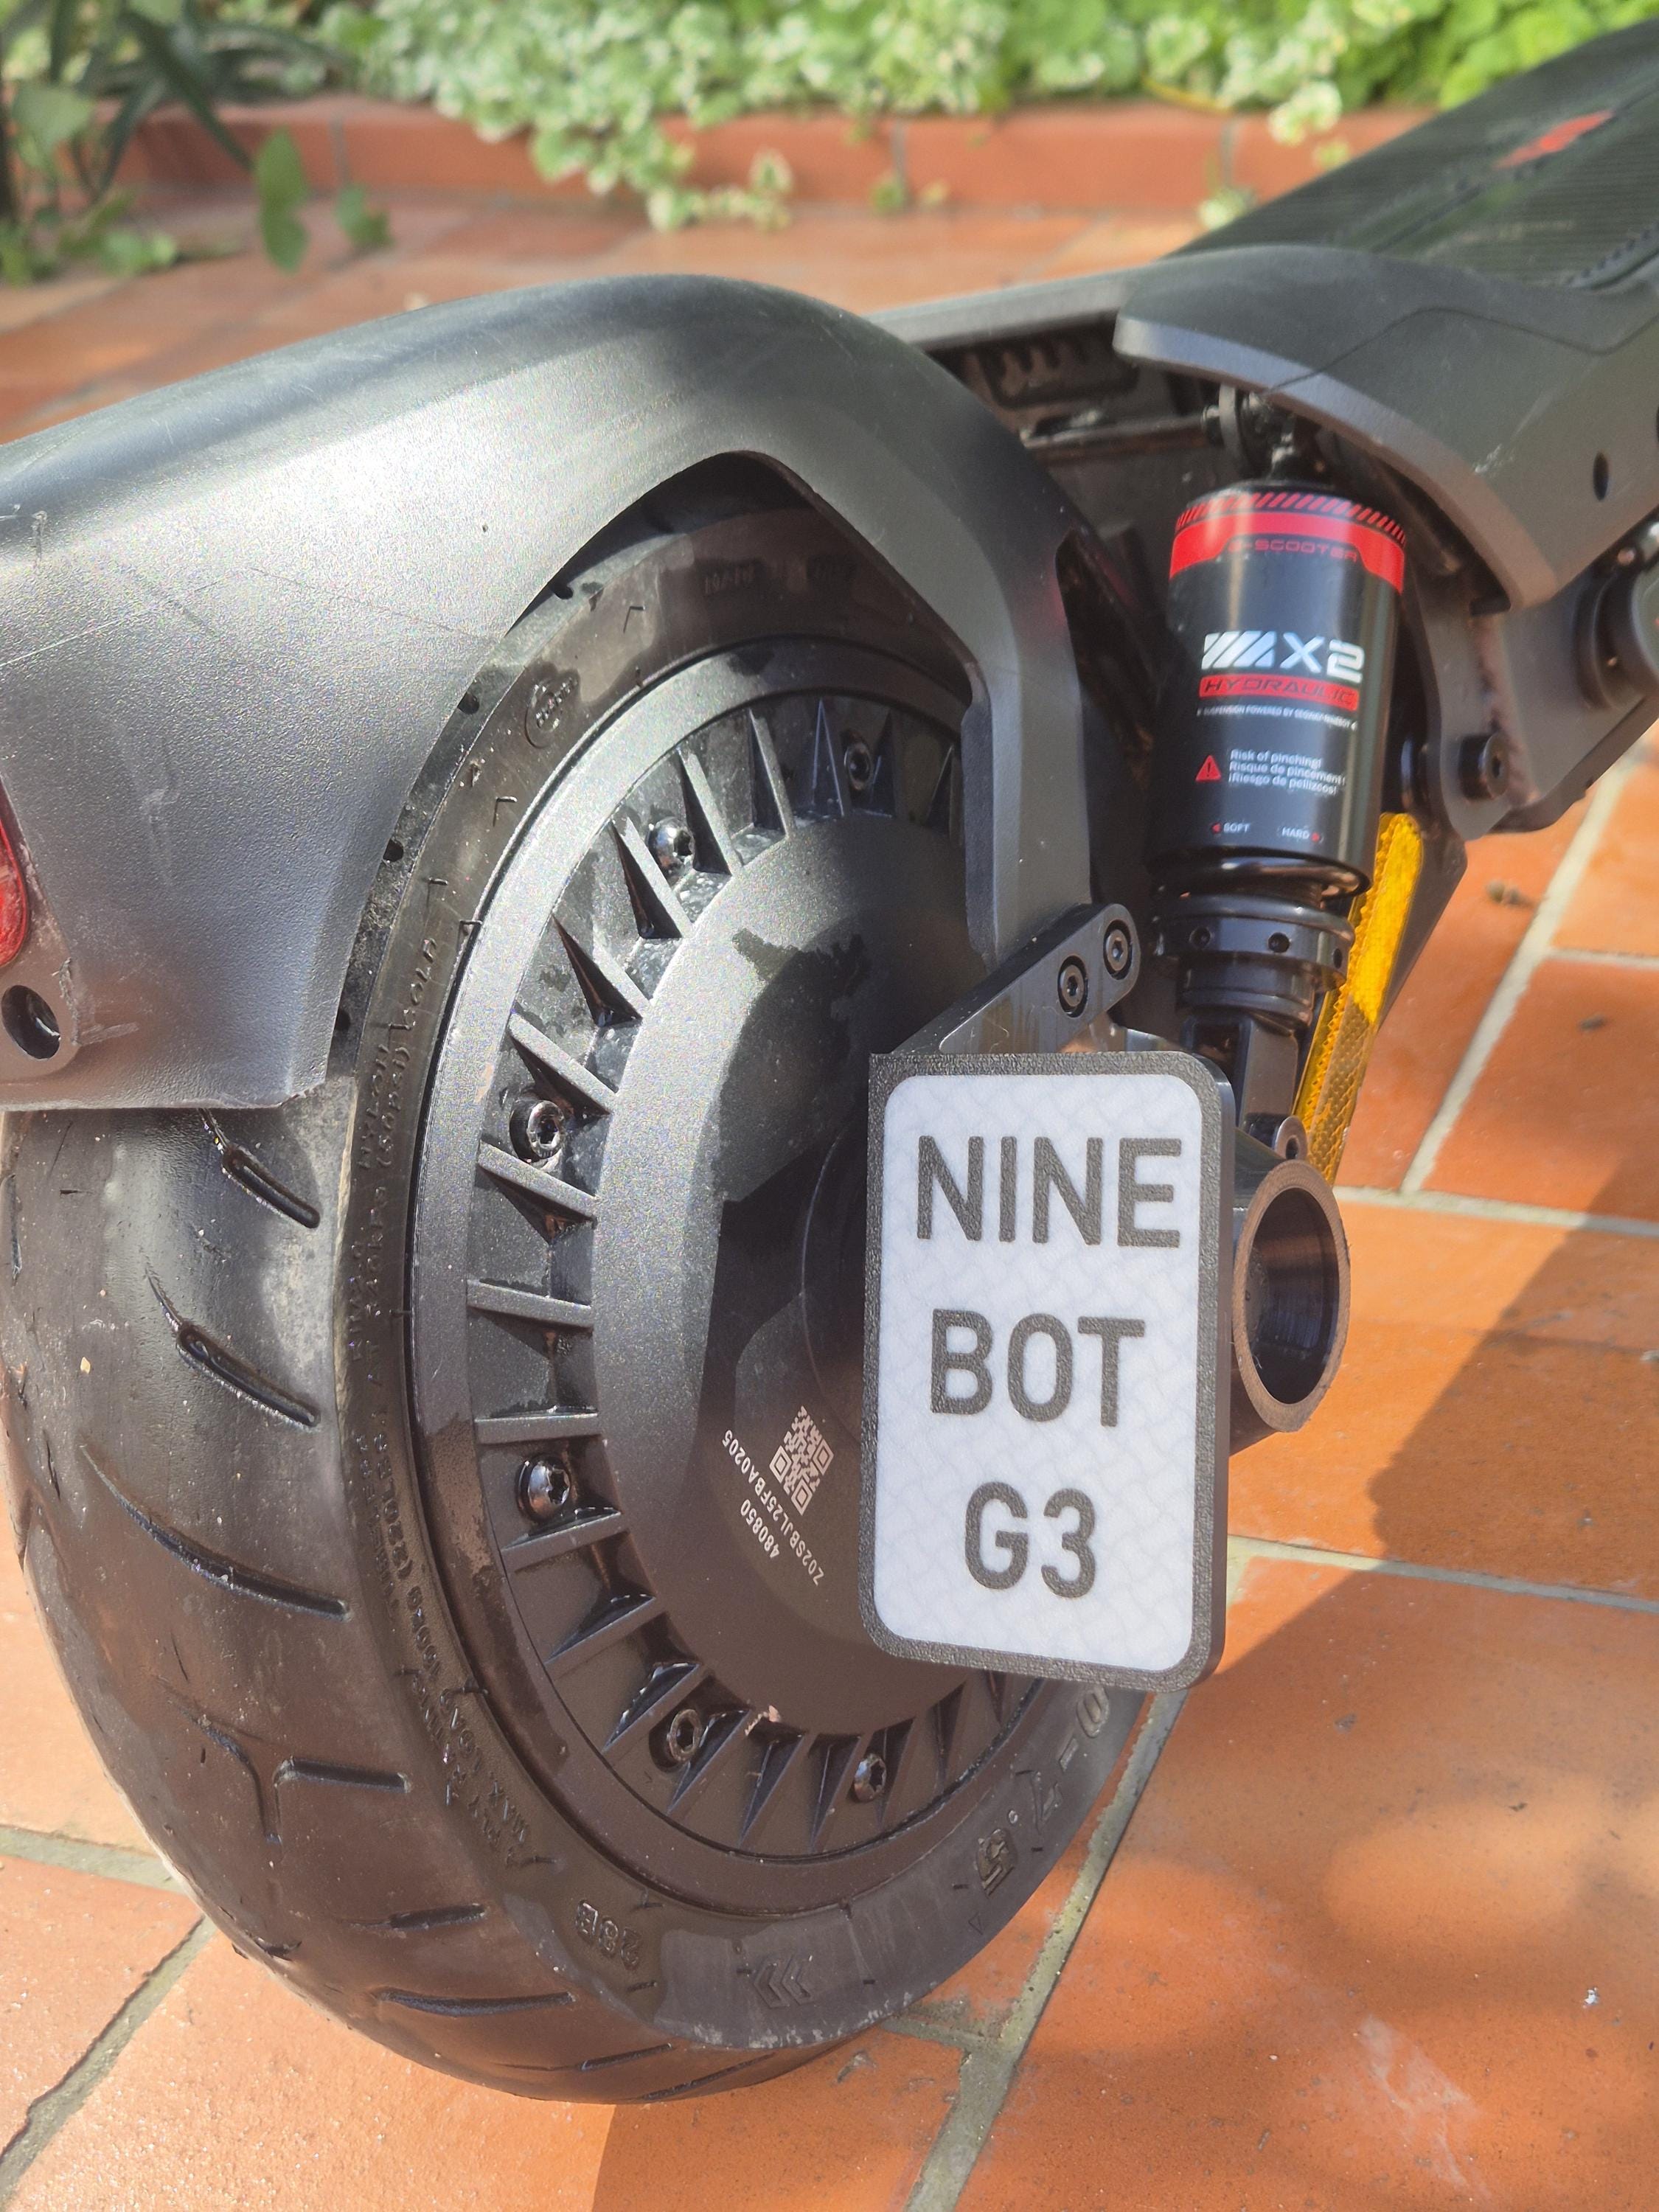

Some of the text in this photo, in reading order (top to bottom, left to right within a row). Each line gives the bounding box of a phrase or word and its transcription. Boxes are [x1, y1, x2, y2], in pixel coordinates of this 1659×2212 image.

[1205, 678, 1356, 705] HYDRAULIC
[1231, 748, 1322, 769] Risk of pinching!
[1229, 761, 1346, 786] Risque de pincement!
[1273, 774, 1287, 786] de
[1223, 823, 1310, 839] SOFT HARD
[917, 1135, 1181, 1247] NINE
[931, 1308, 1145, 1427] BOT
[740, 1499, 779, 1559] 480850
[964, 1481, 1096, 1599] G3
